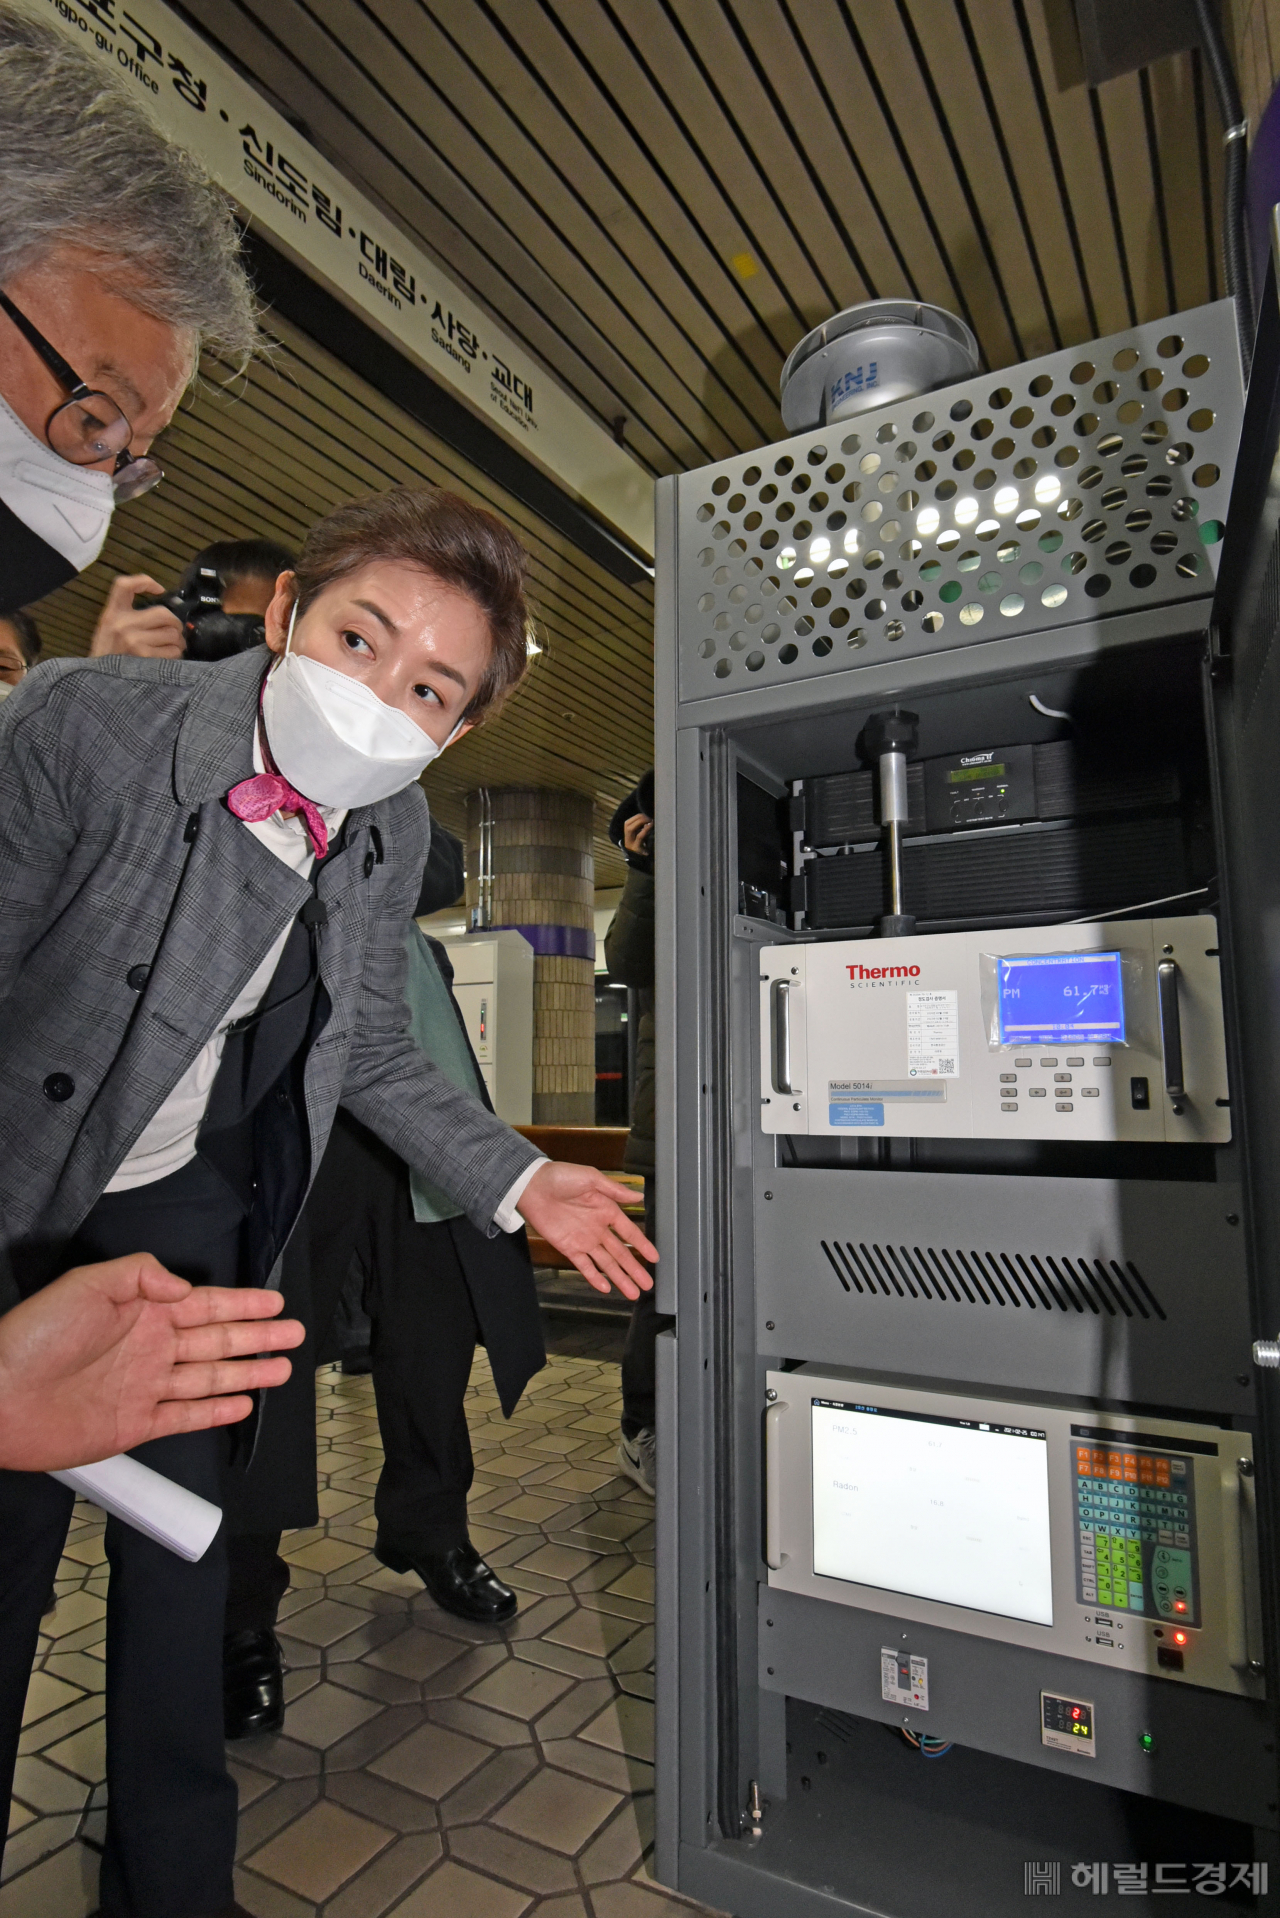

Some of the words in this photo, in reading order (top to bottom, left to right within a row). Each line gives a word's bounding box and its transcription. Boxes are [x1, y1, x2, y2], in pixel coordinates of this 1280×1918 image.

[117, 48, 159, 94] Office
[244, 159, 307, 223] Sindorim
[239, 123, 342, 238] 신도림
[360, 230, 416, 305] 대림
[431, 301, 480, 359] 사당
[491, 354, 533, 413] 교대
[359, 262, 401, 311] Daerim
[431, 327, 471, 374] Sadang
[831, 362, 877, 404] KNJ
[846, 965, 920, 980] Thermo
[850, 980, 920, 988] SCIENTIFIC
[1003, 989, 1020, 999] PM
[1063, 985, 1098, 996] 61.7
[832, 1425, 858, 1435] PM2.5
[1125, 1472, 1136, 1480] F10
[832, 1480, 859, 1492] Radon
[1072, 1707, 1080, 1719] 2
[1073, 1723, 1088, 1735] 24
